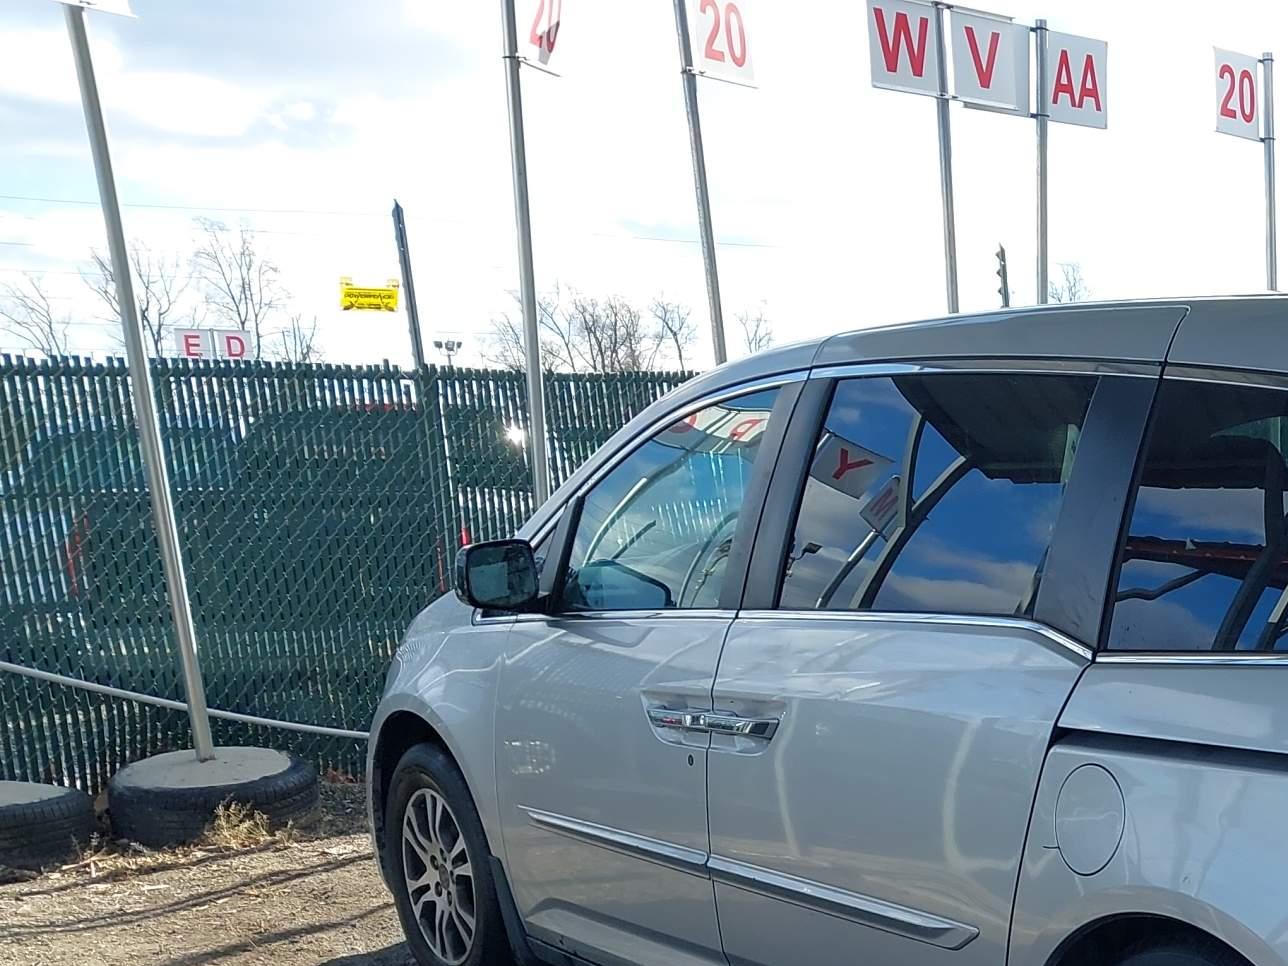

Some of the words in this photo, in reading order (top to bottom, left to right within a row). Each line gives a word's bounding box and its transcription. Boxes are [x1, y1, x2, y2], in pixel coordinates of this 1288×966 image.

[700, 0, 746, 67] 20
[872, 7, 929, 78] W
[964, 26, 1000, 89] V
[1052, 49, 1102, 112] AA
[1219, 64, 1255, 123] 20
[184, 335, 203, 356] E
[226, 336, 245, 357] D
